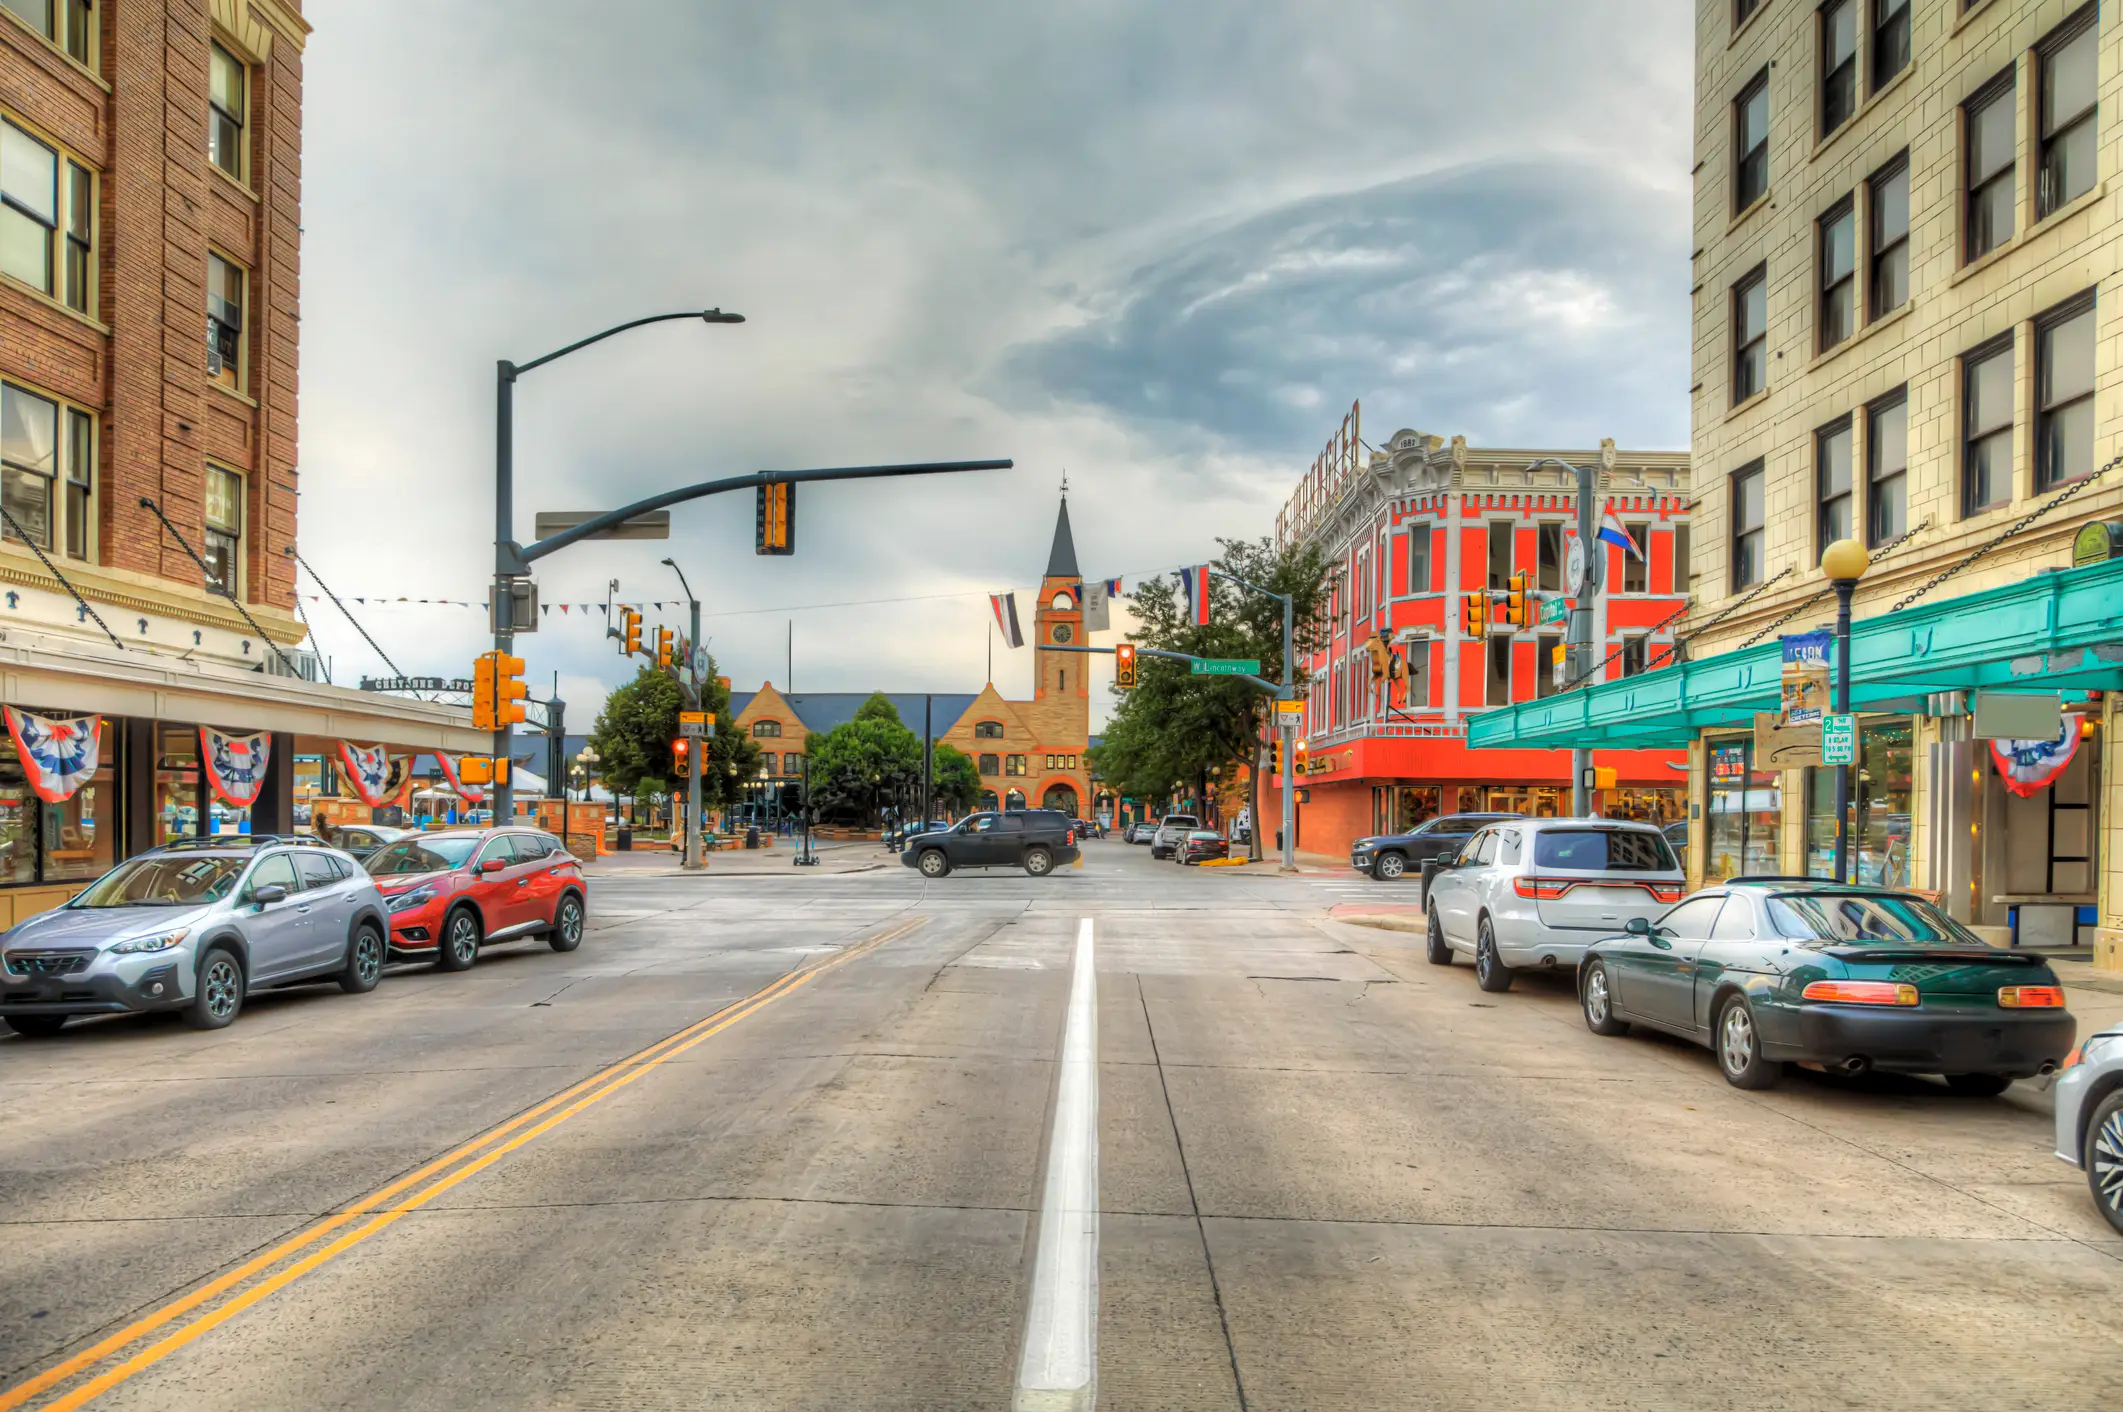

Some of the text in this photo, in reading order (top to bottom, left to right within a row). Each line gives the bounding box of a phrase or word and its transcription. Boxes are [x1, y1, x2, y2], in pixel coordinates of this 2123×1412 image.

[1193, 662, 1246, 673] W Lincolnway
[1825, 719, 1832, 731] 2
